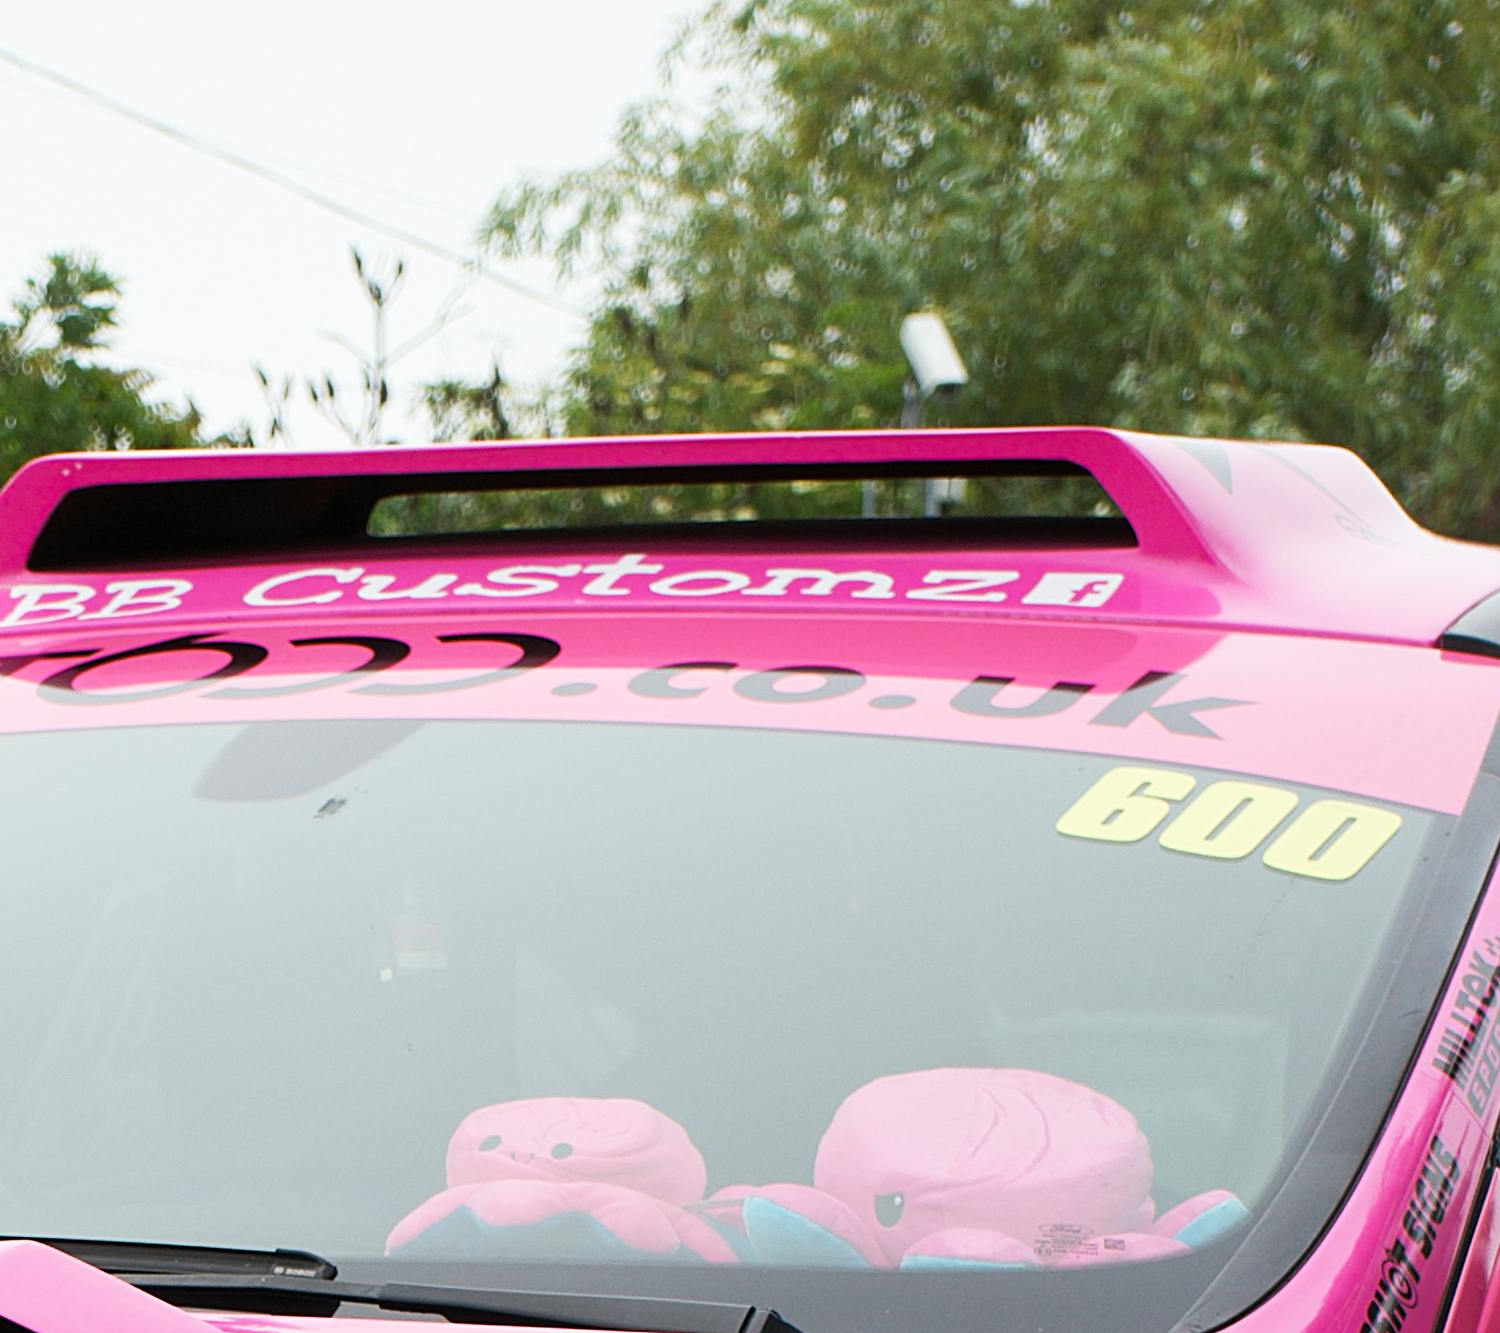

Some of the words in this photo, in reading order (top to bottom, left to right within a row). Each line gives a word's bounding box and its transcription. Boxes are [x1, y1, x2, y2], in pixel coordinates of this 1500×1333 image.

[242, 552, 1019, 607] Customz
[1056, 767, 1402, 881] 600
[1399, 1134, 1461, 1257] SIGNS
